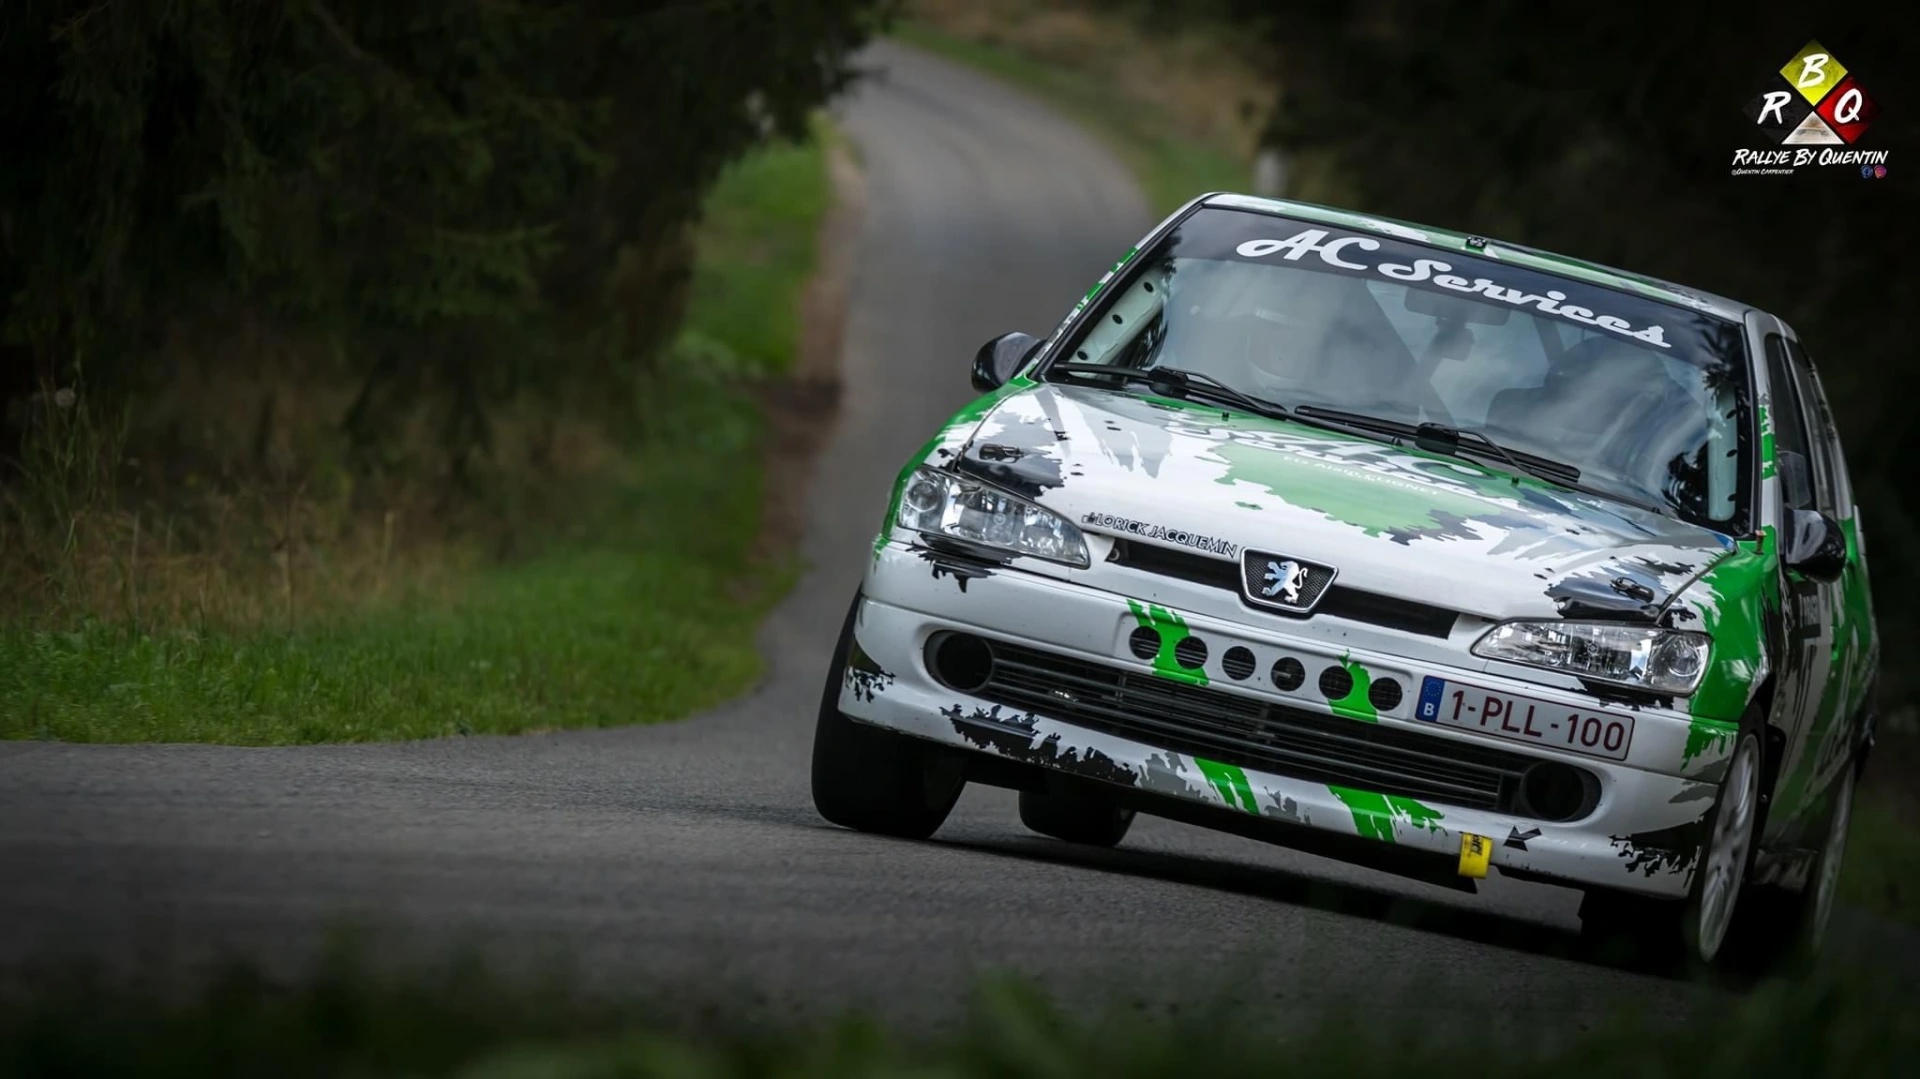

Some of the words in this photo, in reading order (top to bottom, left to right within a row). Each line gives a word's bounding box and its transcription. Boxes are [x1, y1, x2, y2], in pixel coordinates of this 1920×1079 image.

[1236, 228, 1380, 270] AC
[1377, 259, 1672, 348] Services
[1148, 525, 1238, 559] JACQUEMIN
[1423, 702, 1435, 717] B
[1452, 690, 1625, 752] 1-PLL-100
